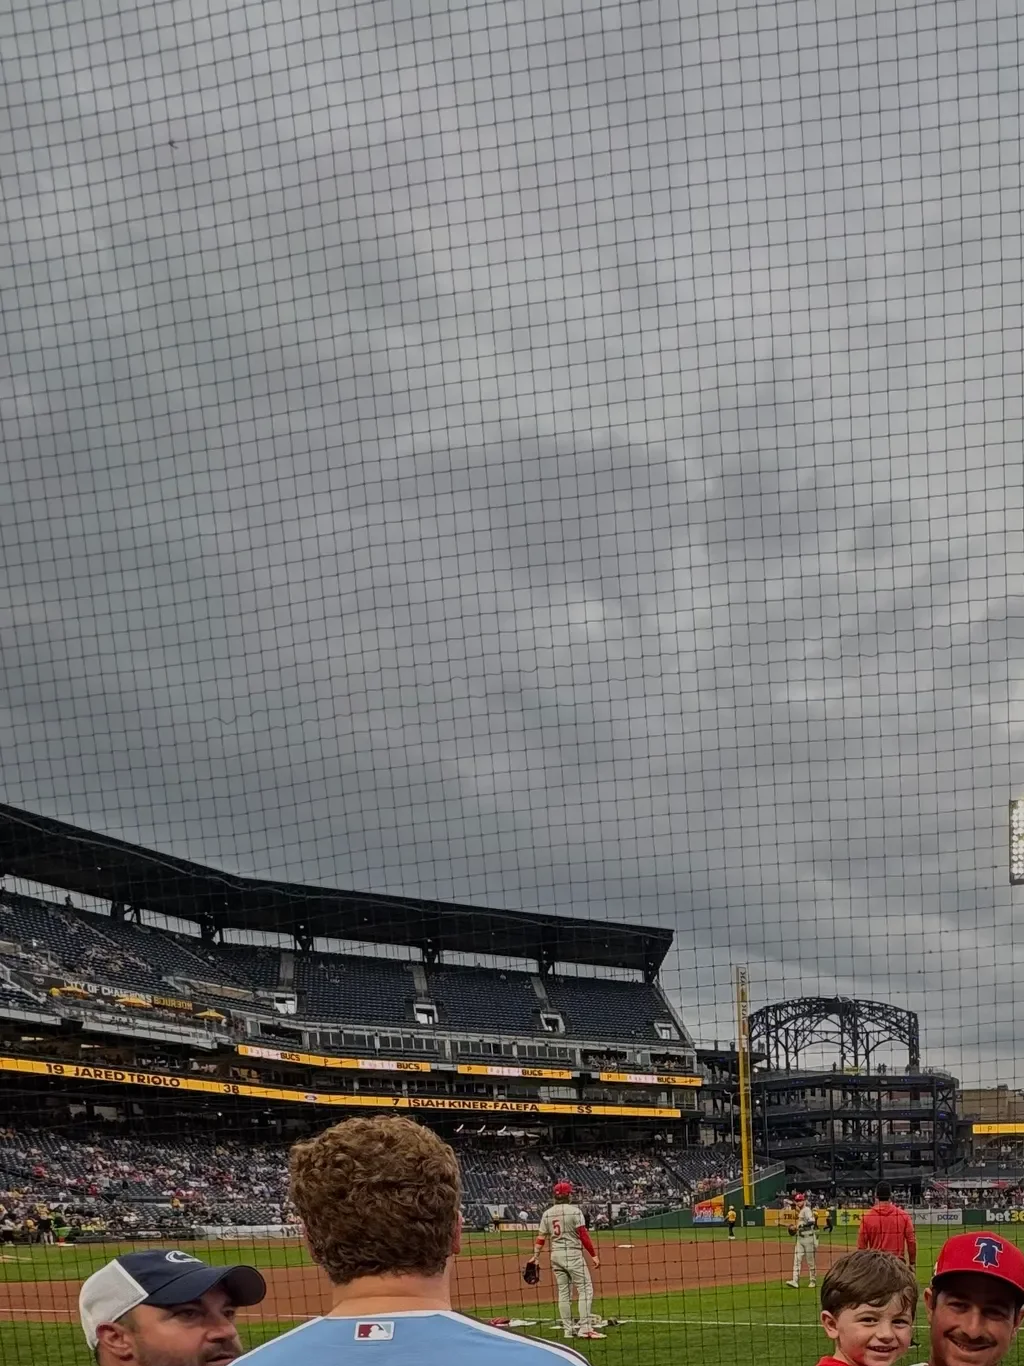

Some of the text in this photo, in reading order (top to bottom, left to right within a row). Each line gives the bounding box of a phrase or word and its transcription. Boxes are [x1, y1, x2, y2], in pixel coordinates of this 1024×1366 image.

[87, 984, 99, 995] OF
[280, 1052, 300, 1062] BUCS
[396, 1062, 420, 1070] BUCS
[521, 1069, 544, 1077] BUCS
[46, 1064, 240, 1094] 19 JARED TRIOLO 3B
[656, 1076, 676, 1084] BUCS
[392, 1098, 400, 1106] 7
[408, 1098, 445, 1108] ISIAH
[450, 1100, 540, 1112] KINER-FALEFA
[552, 1220, 561, 1236] 5
